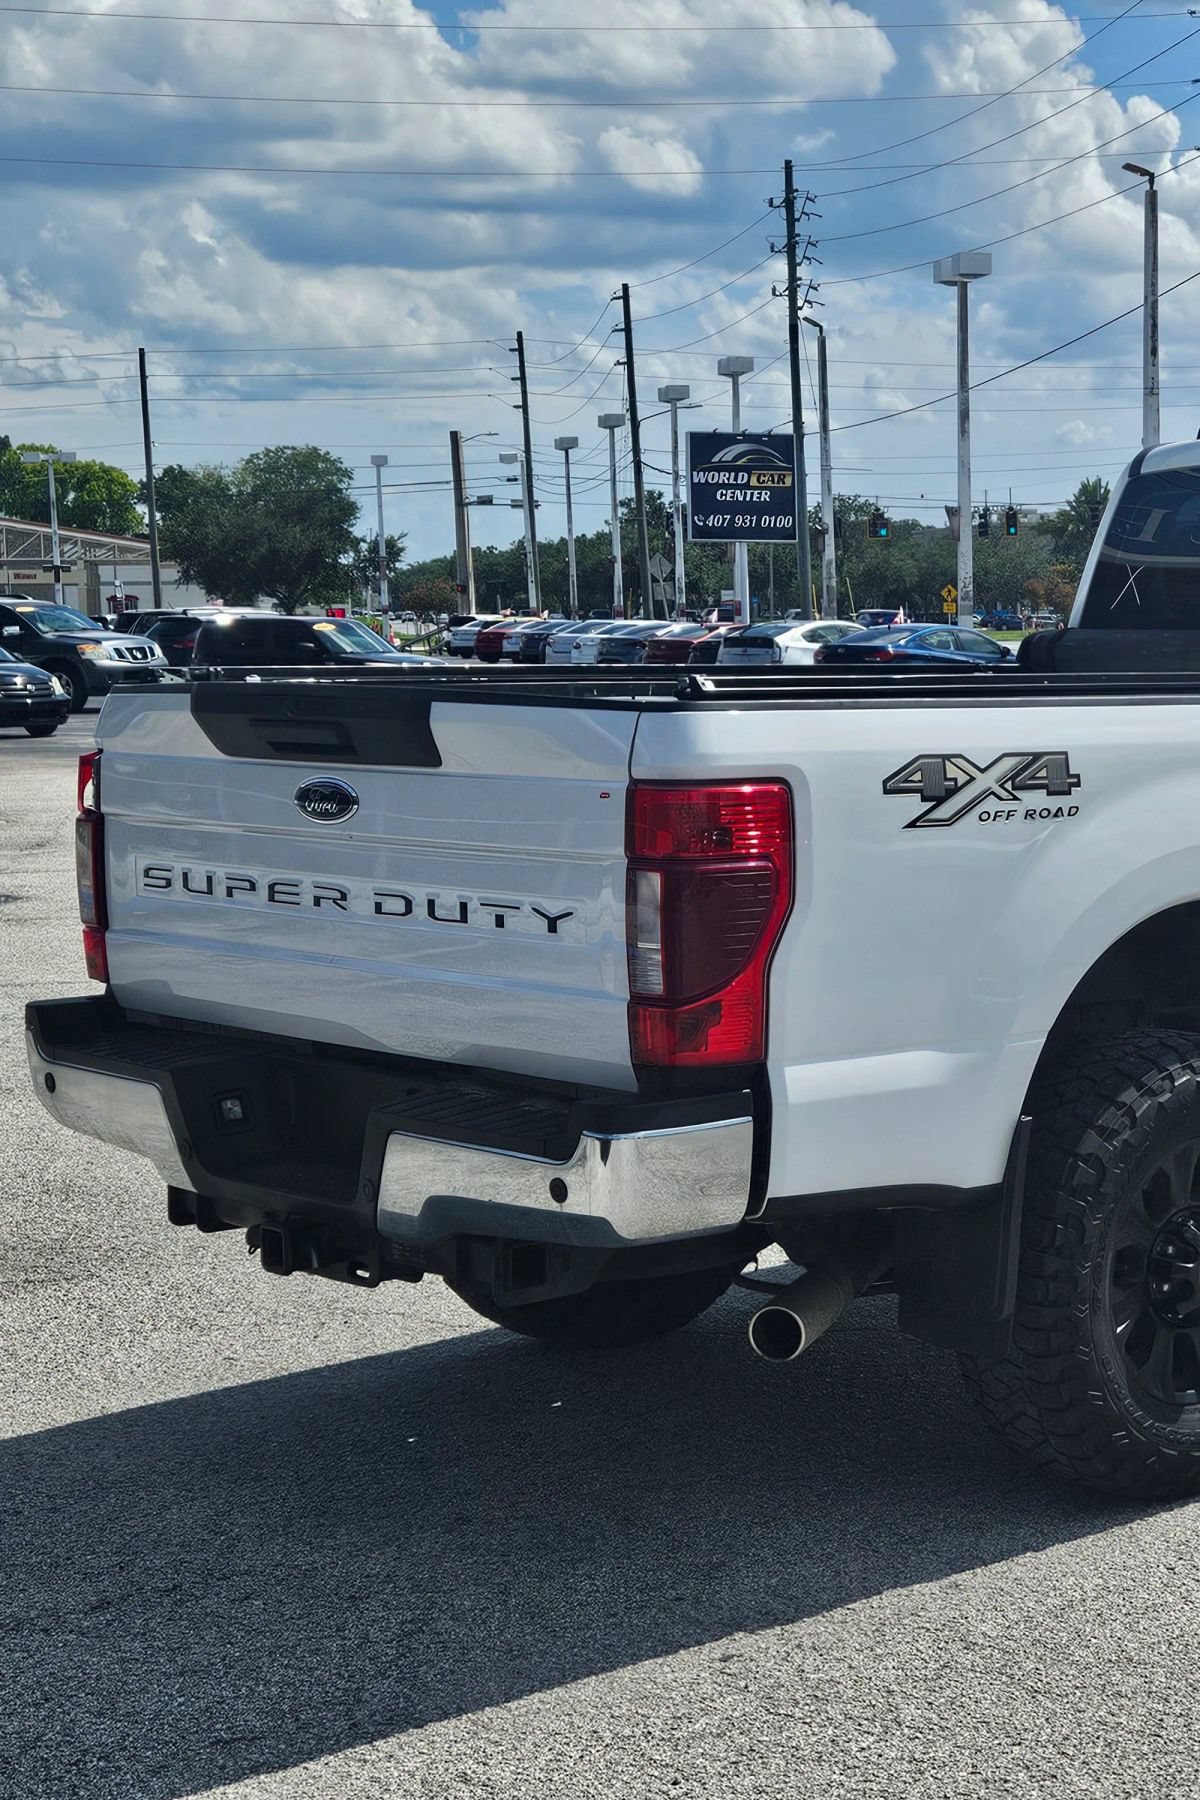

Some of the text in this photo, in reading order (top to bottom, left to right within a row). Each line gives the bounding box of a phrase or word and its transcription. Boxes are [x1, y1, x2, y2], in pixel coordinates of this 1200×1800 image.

[692, 471, 787, 485] WORLD CAR
[716, 489, 770, 502] CENTER
[706, 514, 793, 528] 407 931 0100
[978, 805, 1080, 824] OFF ROAD
[142, 863, 576, 935] SUPER DUTY
